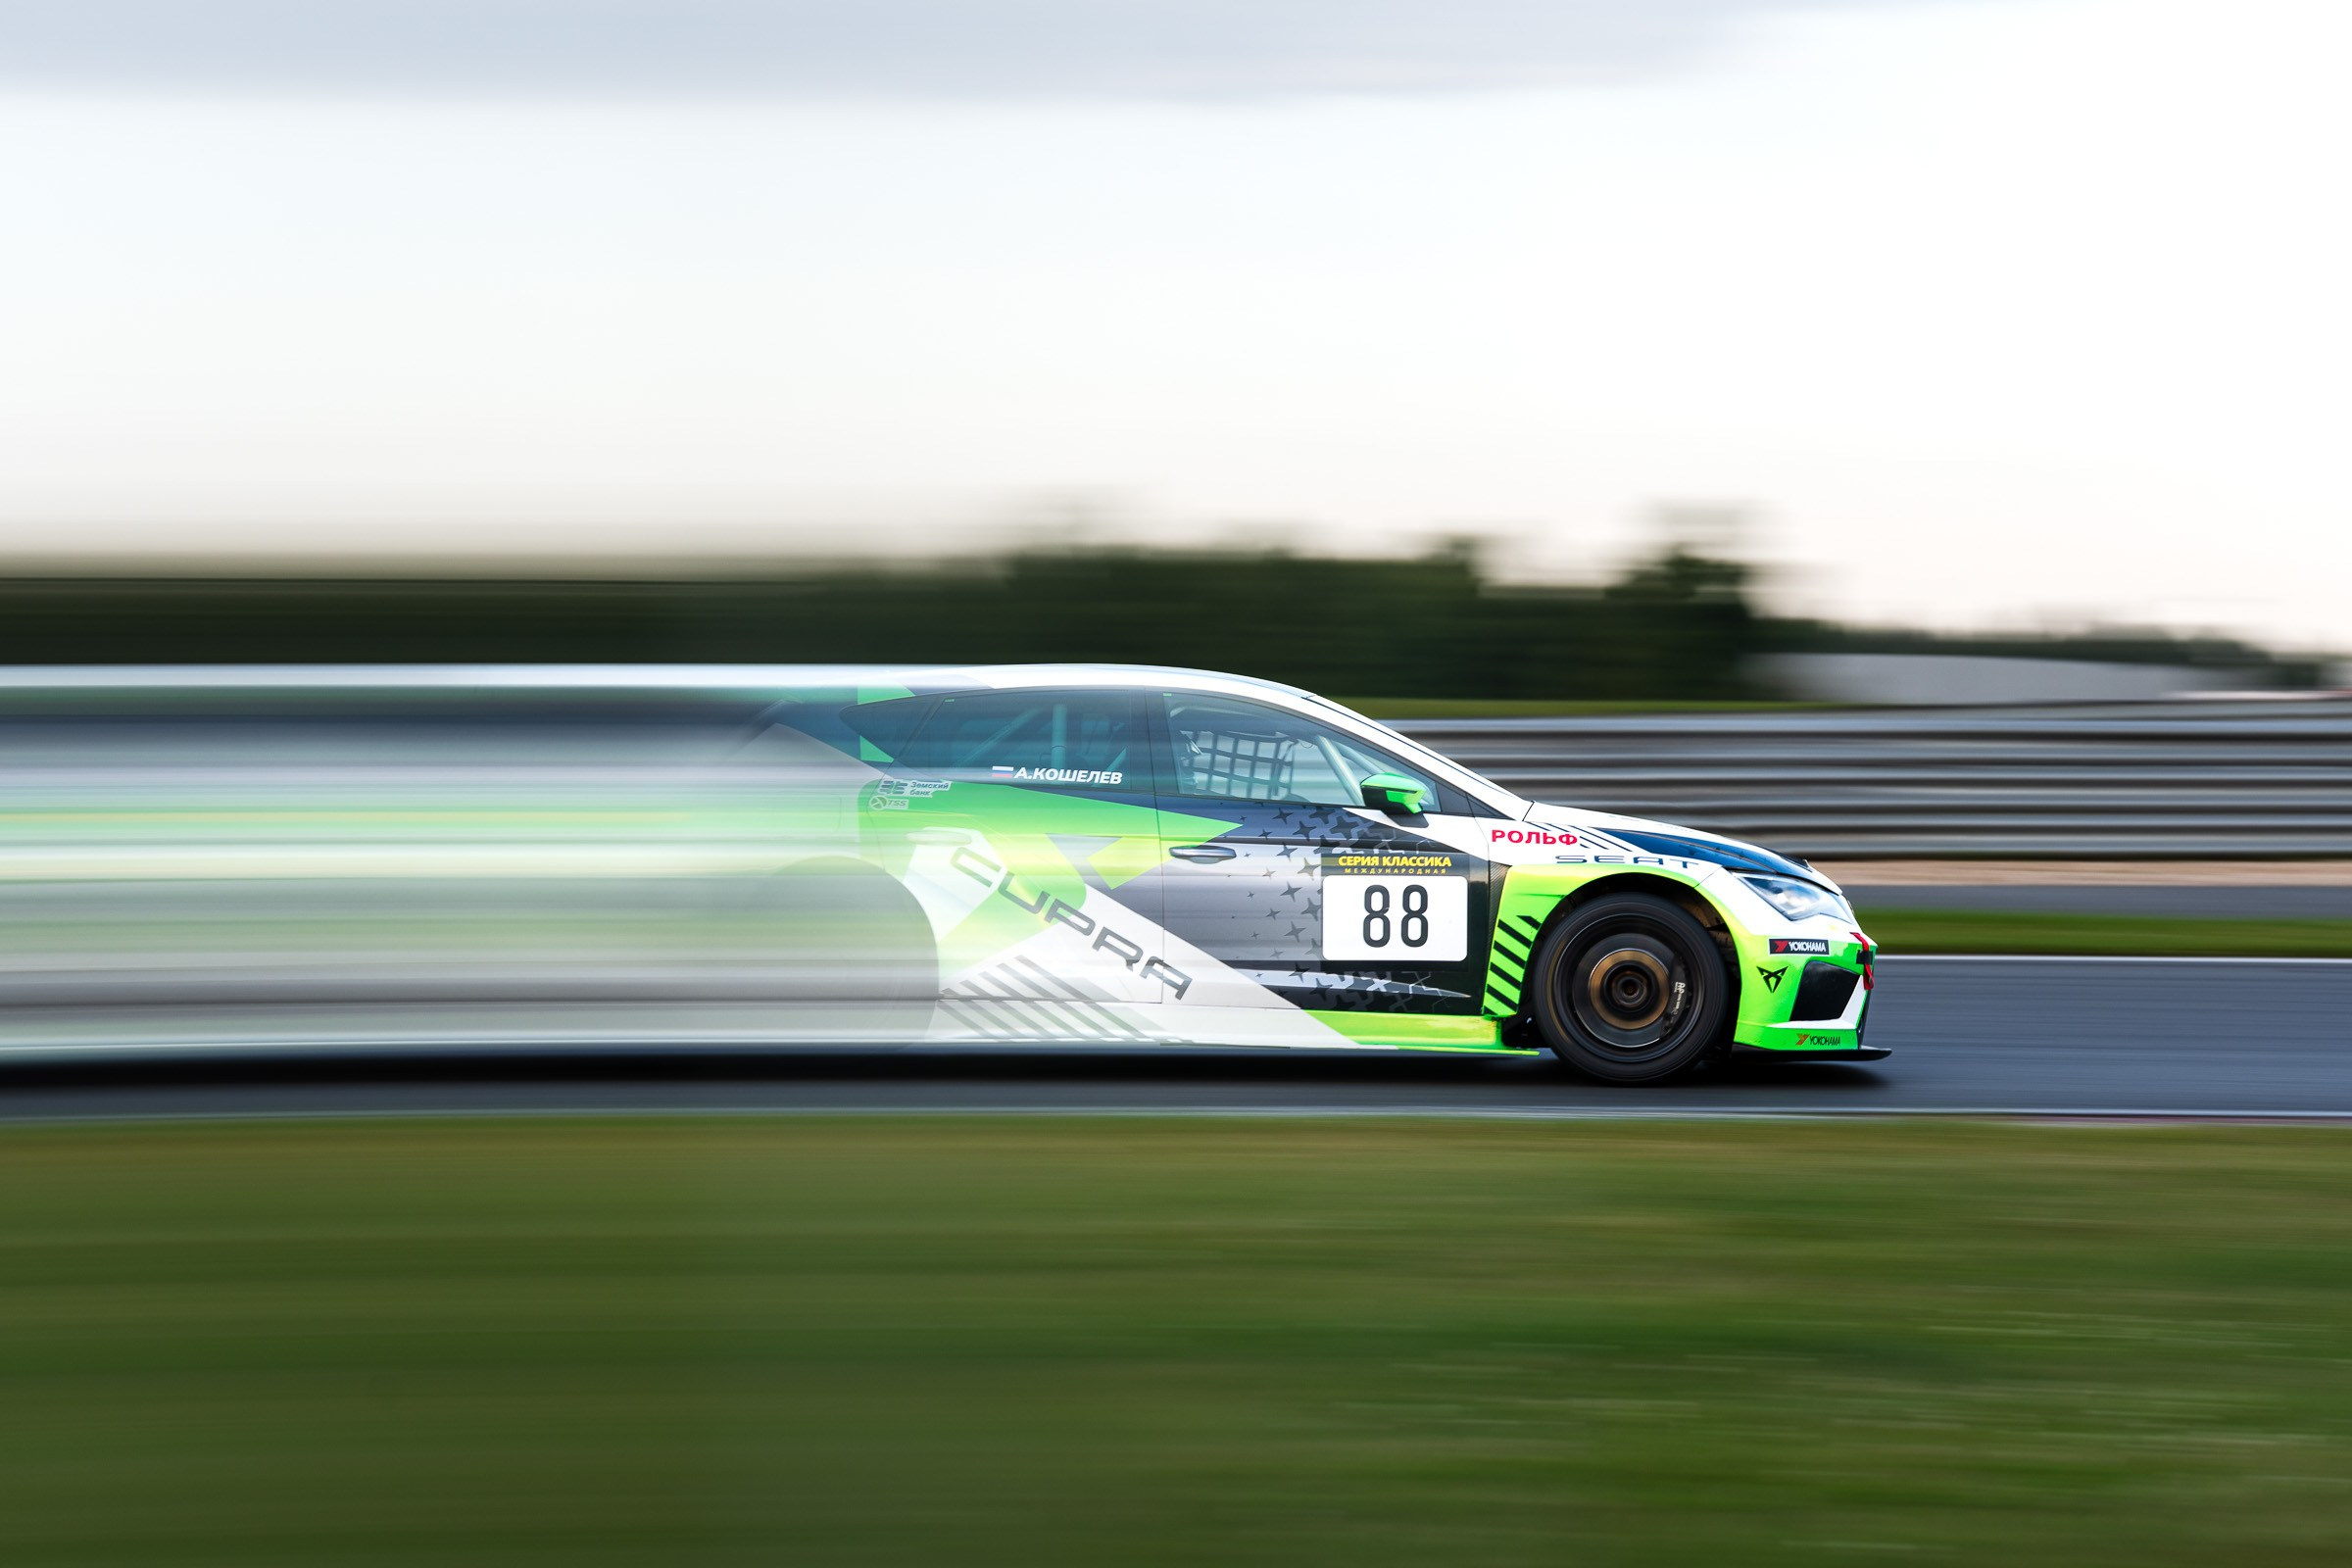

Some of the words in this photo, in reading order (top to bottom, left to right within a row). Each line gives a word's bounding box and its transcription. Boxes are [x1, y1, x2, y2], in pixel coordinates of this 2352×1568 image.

[1013, 766, 1123, 785] А.КОШЕЛЕВ
[910, 781, 950, 790] Земский
[1492, 829, 1578, 845] РОЛЬФ
[1338, 856, 1379, 866] СЕРИЯ
[1382, 856, 1452, 867] КЛАССИКА
[1555, 855, 1699, 869] SEAT
[1362, 884, 1429, 949] 88
[951, 847, 1193, 1001] CUPRA
[1788, 941, 1827, 953] YOKOHAMA
[1809, 1035, 1841, 1046] YOKOHAMA
